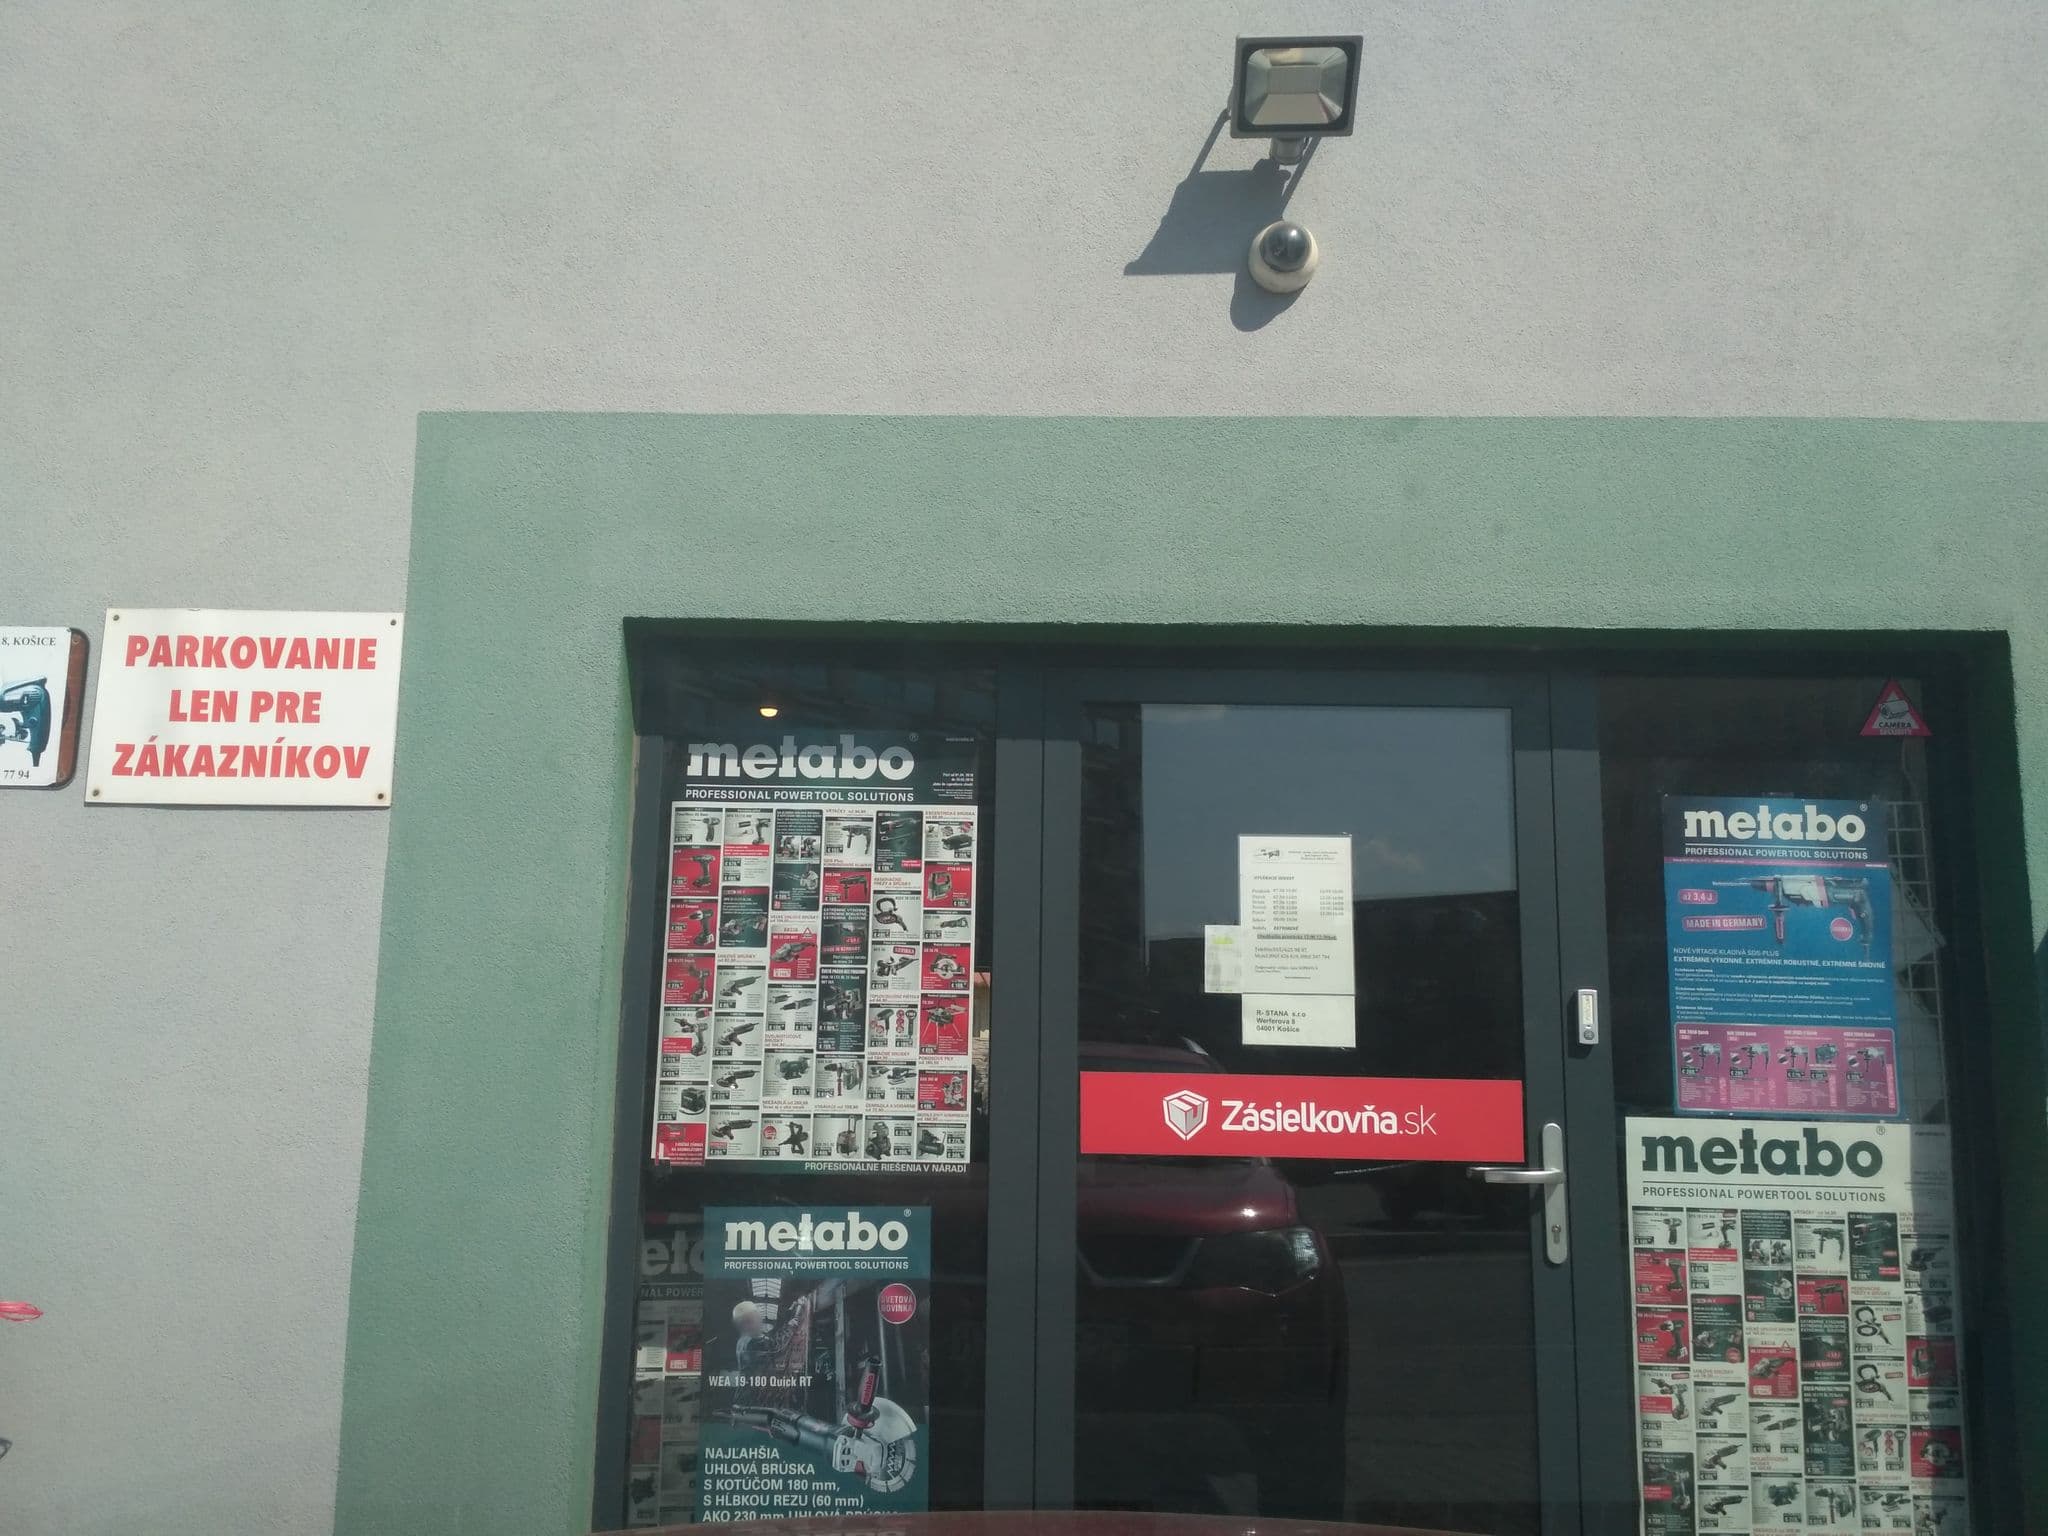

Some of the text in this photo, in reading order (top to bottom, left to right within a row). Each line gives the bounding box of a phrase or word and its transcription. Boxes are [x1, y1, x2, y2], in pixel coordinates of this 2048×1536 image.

[13, 635, 56, 647] KOŠICE
[125, 635, 377, 670] PARKOVANIE
[168, 689, 322, 724] LEN PRE
[111, 735, 371, 779] ZÁKAZNÍKOV
[686, 734, 915, 780] metabo
[18, 770, 30, 781] 94
[686, 788, 771, 800] PROFESSIONAL
[847, 792, 914, 802] SOLUTIONS
[1684, 805, 1866, 842] metabo
[1685, 848, 1754, 858] PROFESSIONAL
[1814, 850, 1868, 860] SOLUTIONS
[1686, 918, 1764, 928] MADE IN GERMANY
[1221, 1100, 1437, 1136] Zásielkovňa.sk
[1641, 1127, 1884, 1178] metabo
[923, 1164, 930, 1173] V
[1642, 1186, 1734, 1200] PROFESSIONAL
[1815, 1190, 1886, 1202] SOLUTIONS
[725, 1211, 909, 1252] metabo
[724, 1260, 792, 1270] PROFESSIONAL
[854, 1260, 909, 1270] SOLUTIONS
[708, 1376, 812, 1388] WEA 19-180 Quick RT
[704, 1461, 815, 1476] UHLOVÁ BRÚSKA
[704, 1476, 840, 1493] S KOTÚČOM 180 mm,
[703, 1495, 712, 1507] S
[812, 1494, 831, 1508] (60
[834, 1494, 864, 1508] mm)
[702, 1510, 730, 1522] AKO
[734, 1510, 756, 1521] 230
